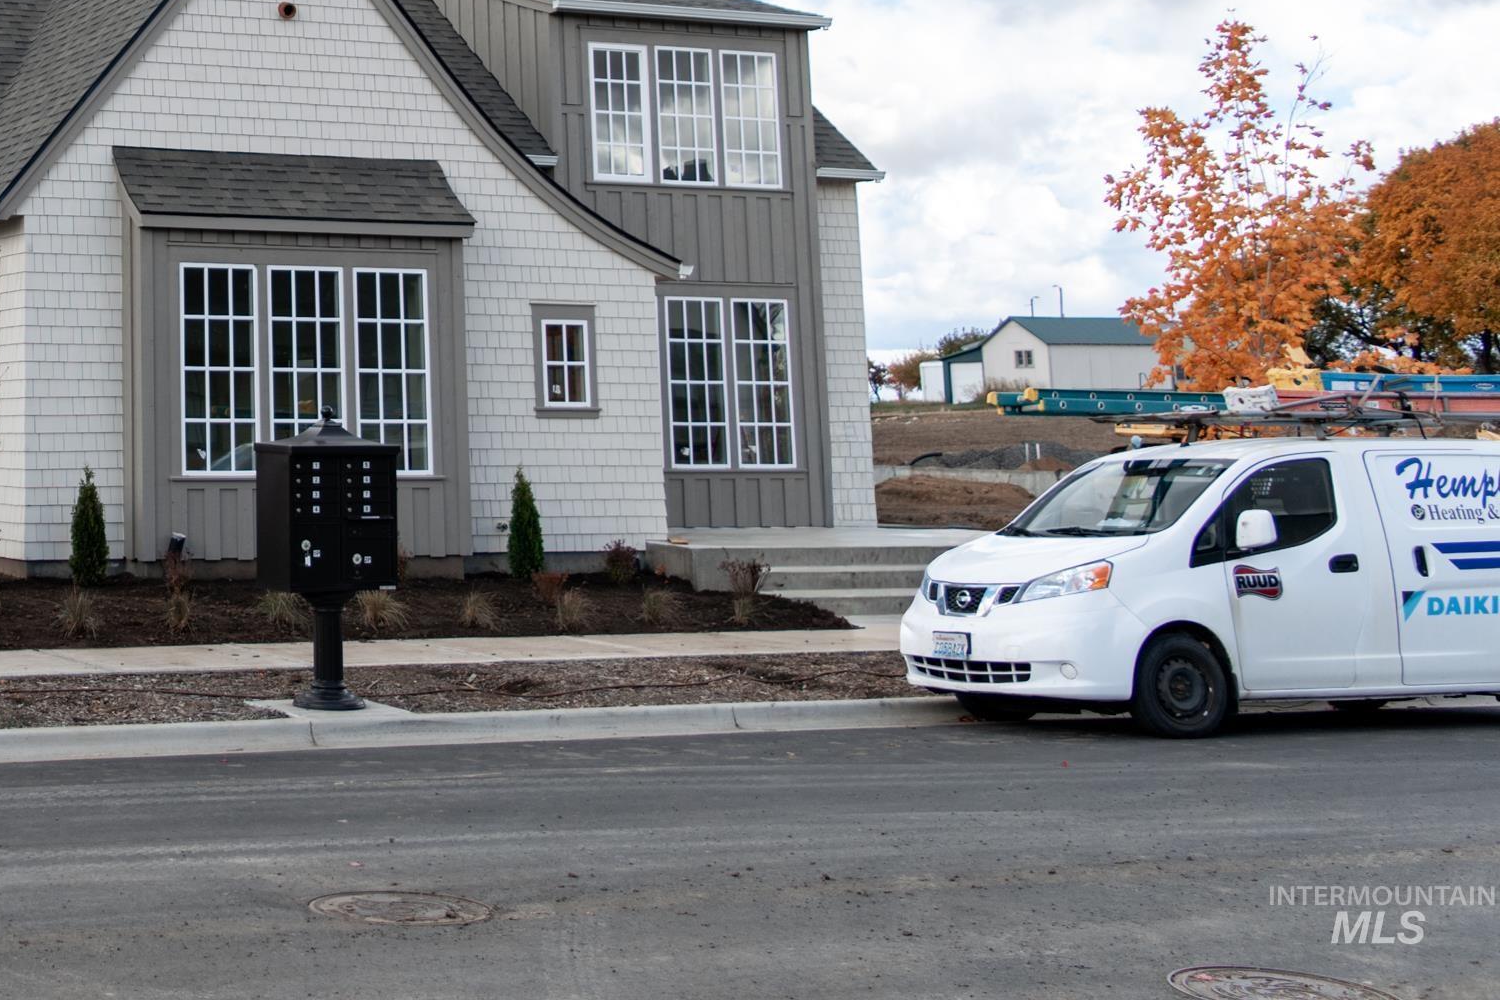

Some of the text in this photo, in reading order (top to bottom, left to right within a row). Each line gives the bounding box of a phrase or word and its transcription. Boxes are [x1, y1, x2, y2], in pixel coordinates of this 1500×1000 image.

[1395, 457, 1500, 509] Hemp
[1427, 504, 1500, 524] Heating &
[1236, 574, 1279, 589] RUUD
